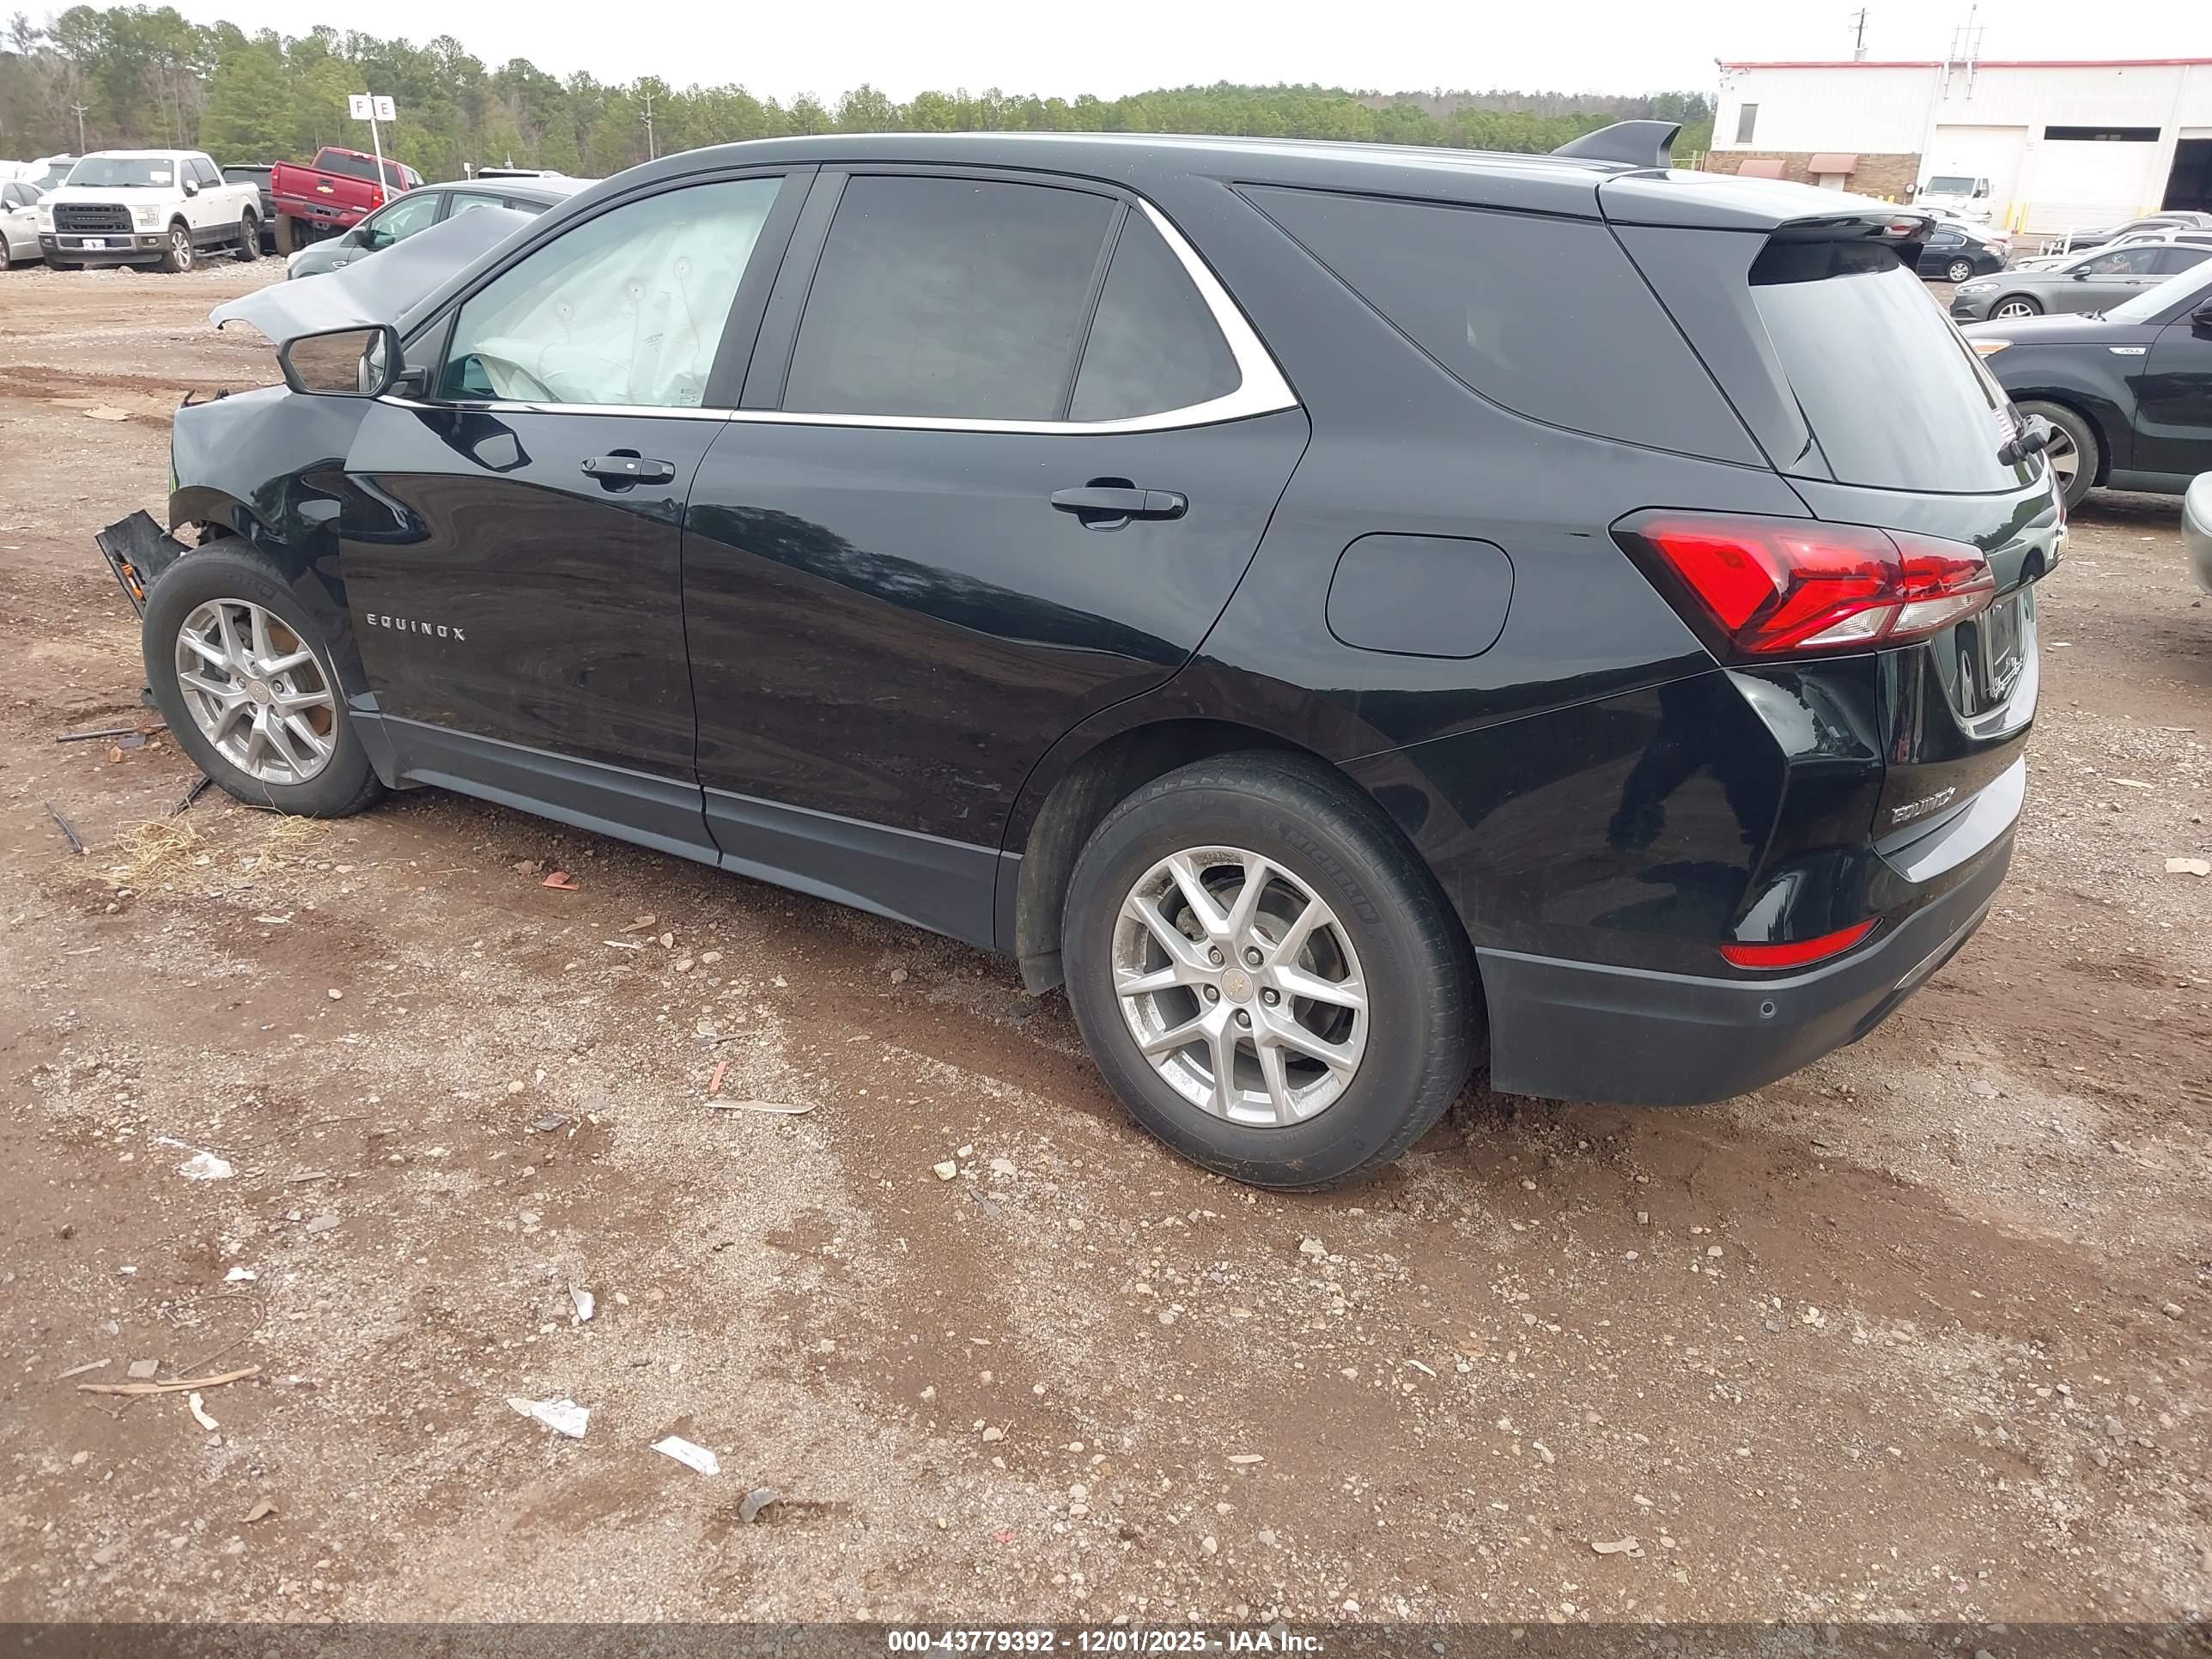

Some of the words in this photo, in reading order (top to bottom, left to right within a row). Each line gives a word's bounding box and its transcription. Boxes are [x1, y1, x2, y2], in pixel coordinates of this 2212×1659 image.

[356, 101, 363, 113] F
[380, 102, 390, 114] E
[367, 612, 467, 641] EQUINOX
